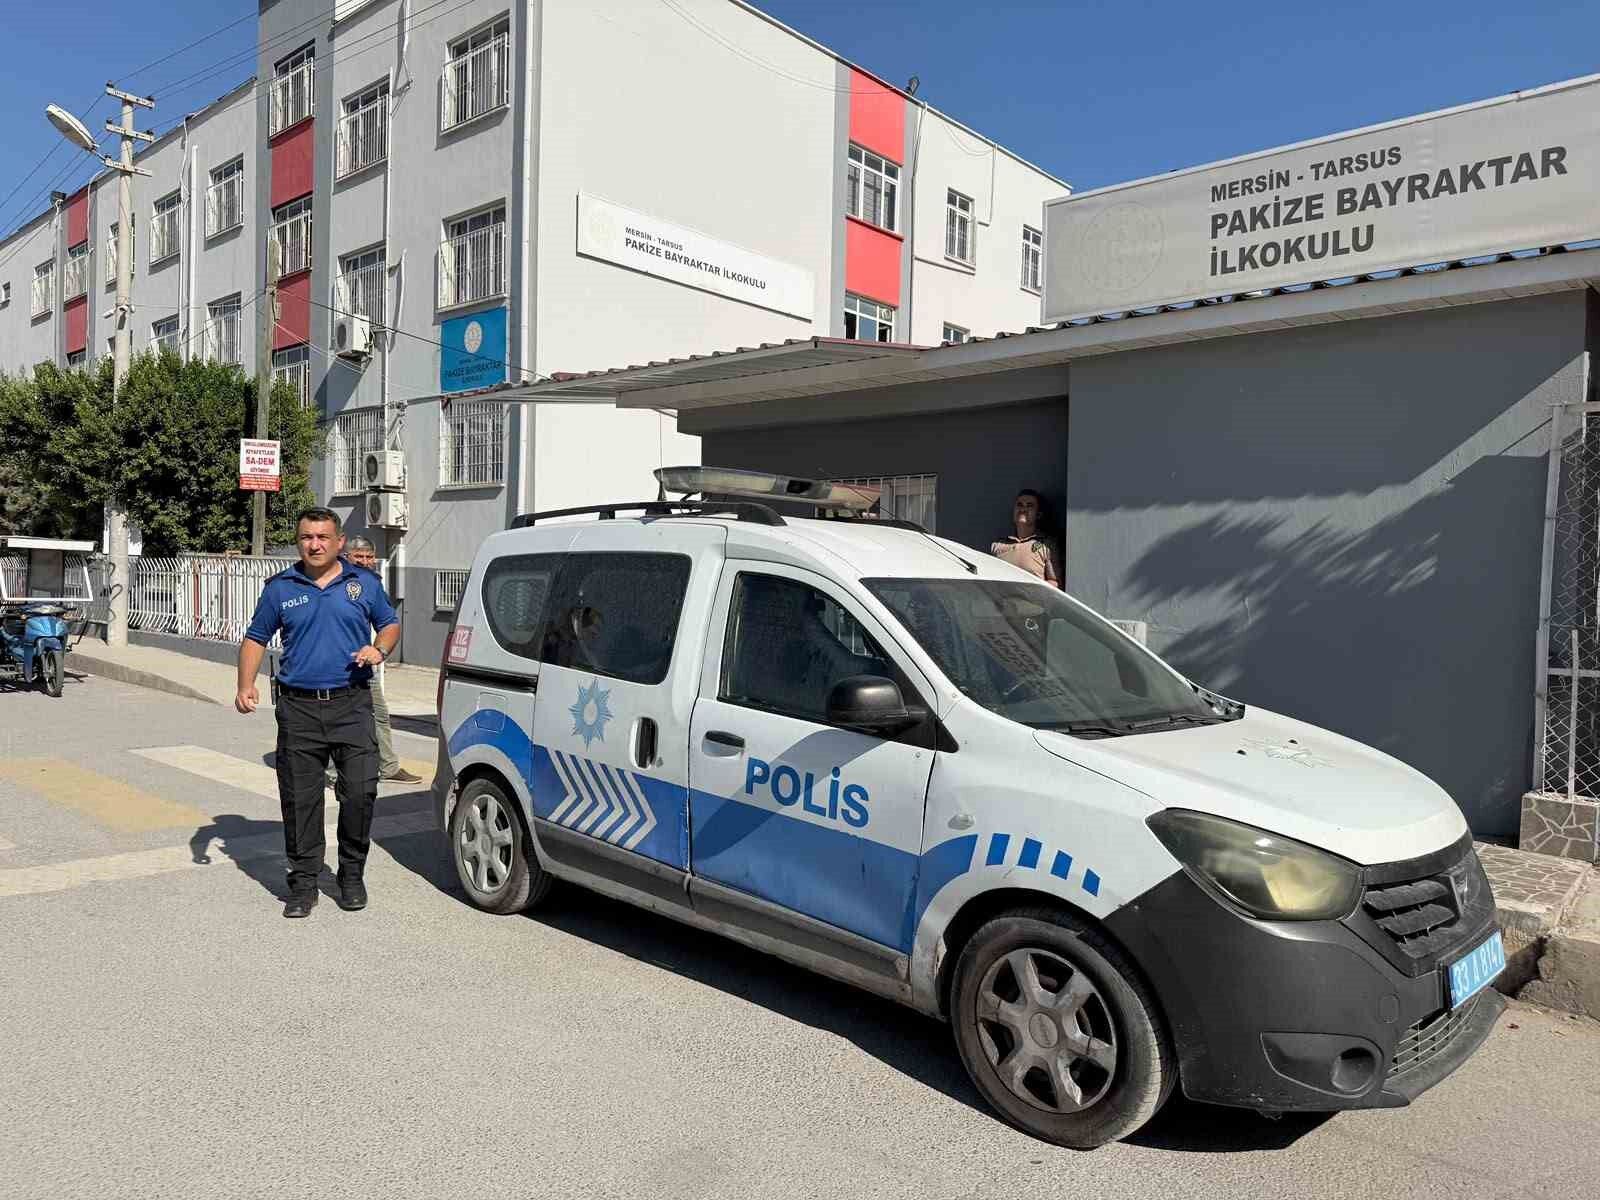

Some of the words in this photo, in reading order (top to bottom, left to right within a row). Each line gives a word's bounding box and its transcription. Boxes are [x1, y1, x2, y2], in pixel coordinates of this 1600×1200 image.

[1210, 193, 1325, 240] PAKİZE
[1336, 145, 1569, 216] BAYRAKTAR
[1211, 168, 1291, 203] MERSİN
[1310, 146, 1403, 182] TARSUS
[625, 226, 652, 242] MERSİN
[657, 237, 683, 251] TARSUS
[625, 237, 662, 257] PAKİZE
[664, 250, 721, 276] BAYRAKTAR
[723, 268, 766, 289] İLKOKULU
[1209, 223, 1375, 277] İLKOKULU
[245, 457, 275, 465] SA-DEM
[745, 756, 870, 828] POLİS
